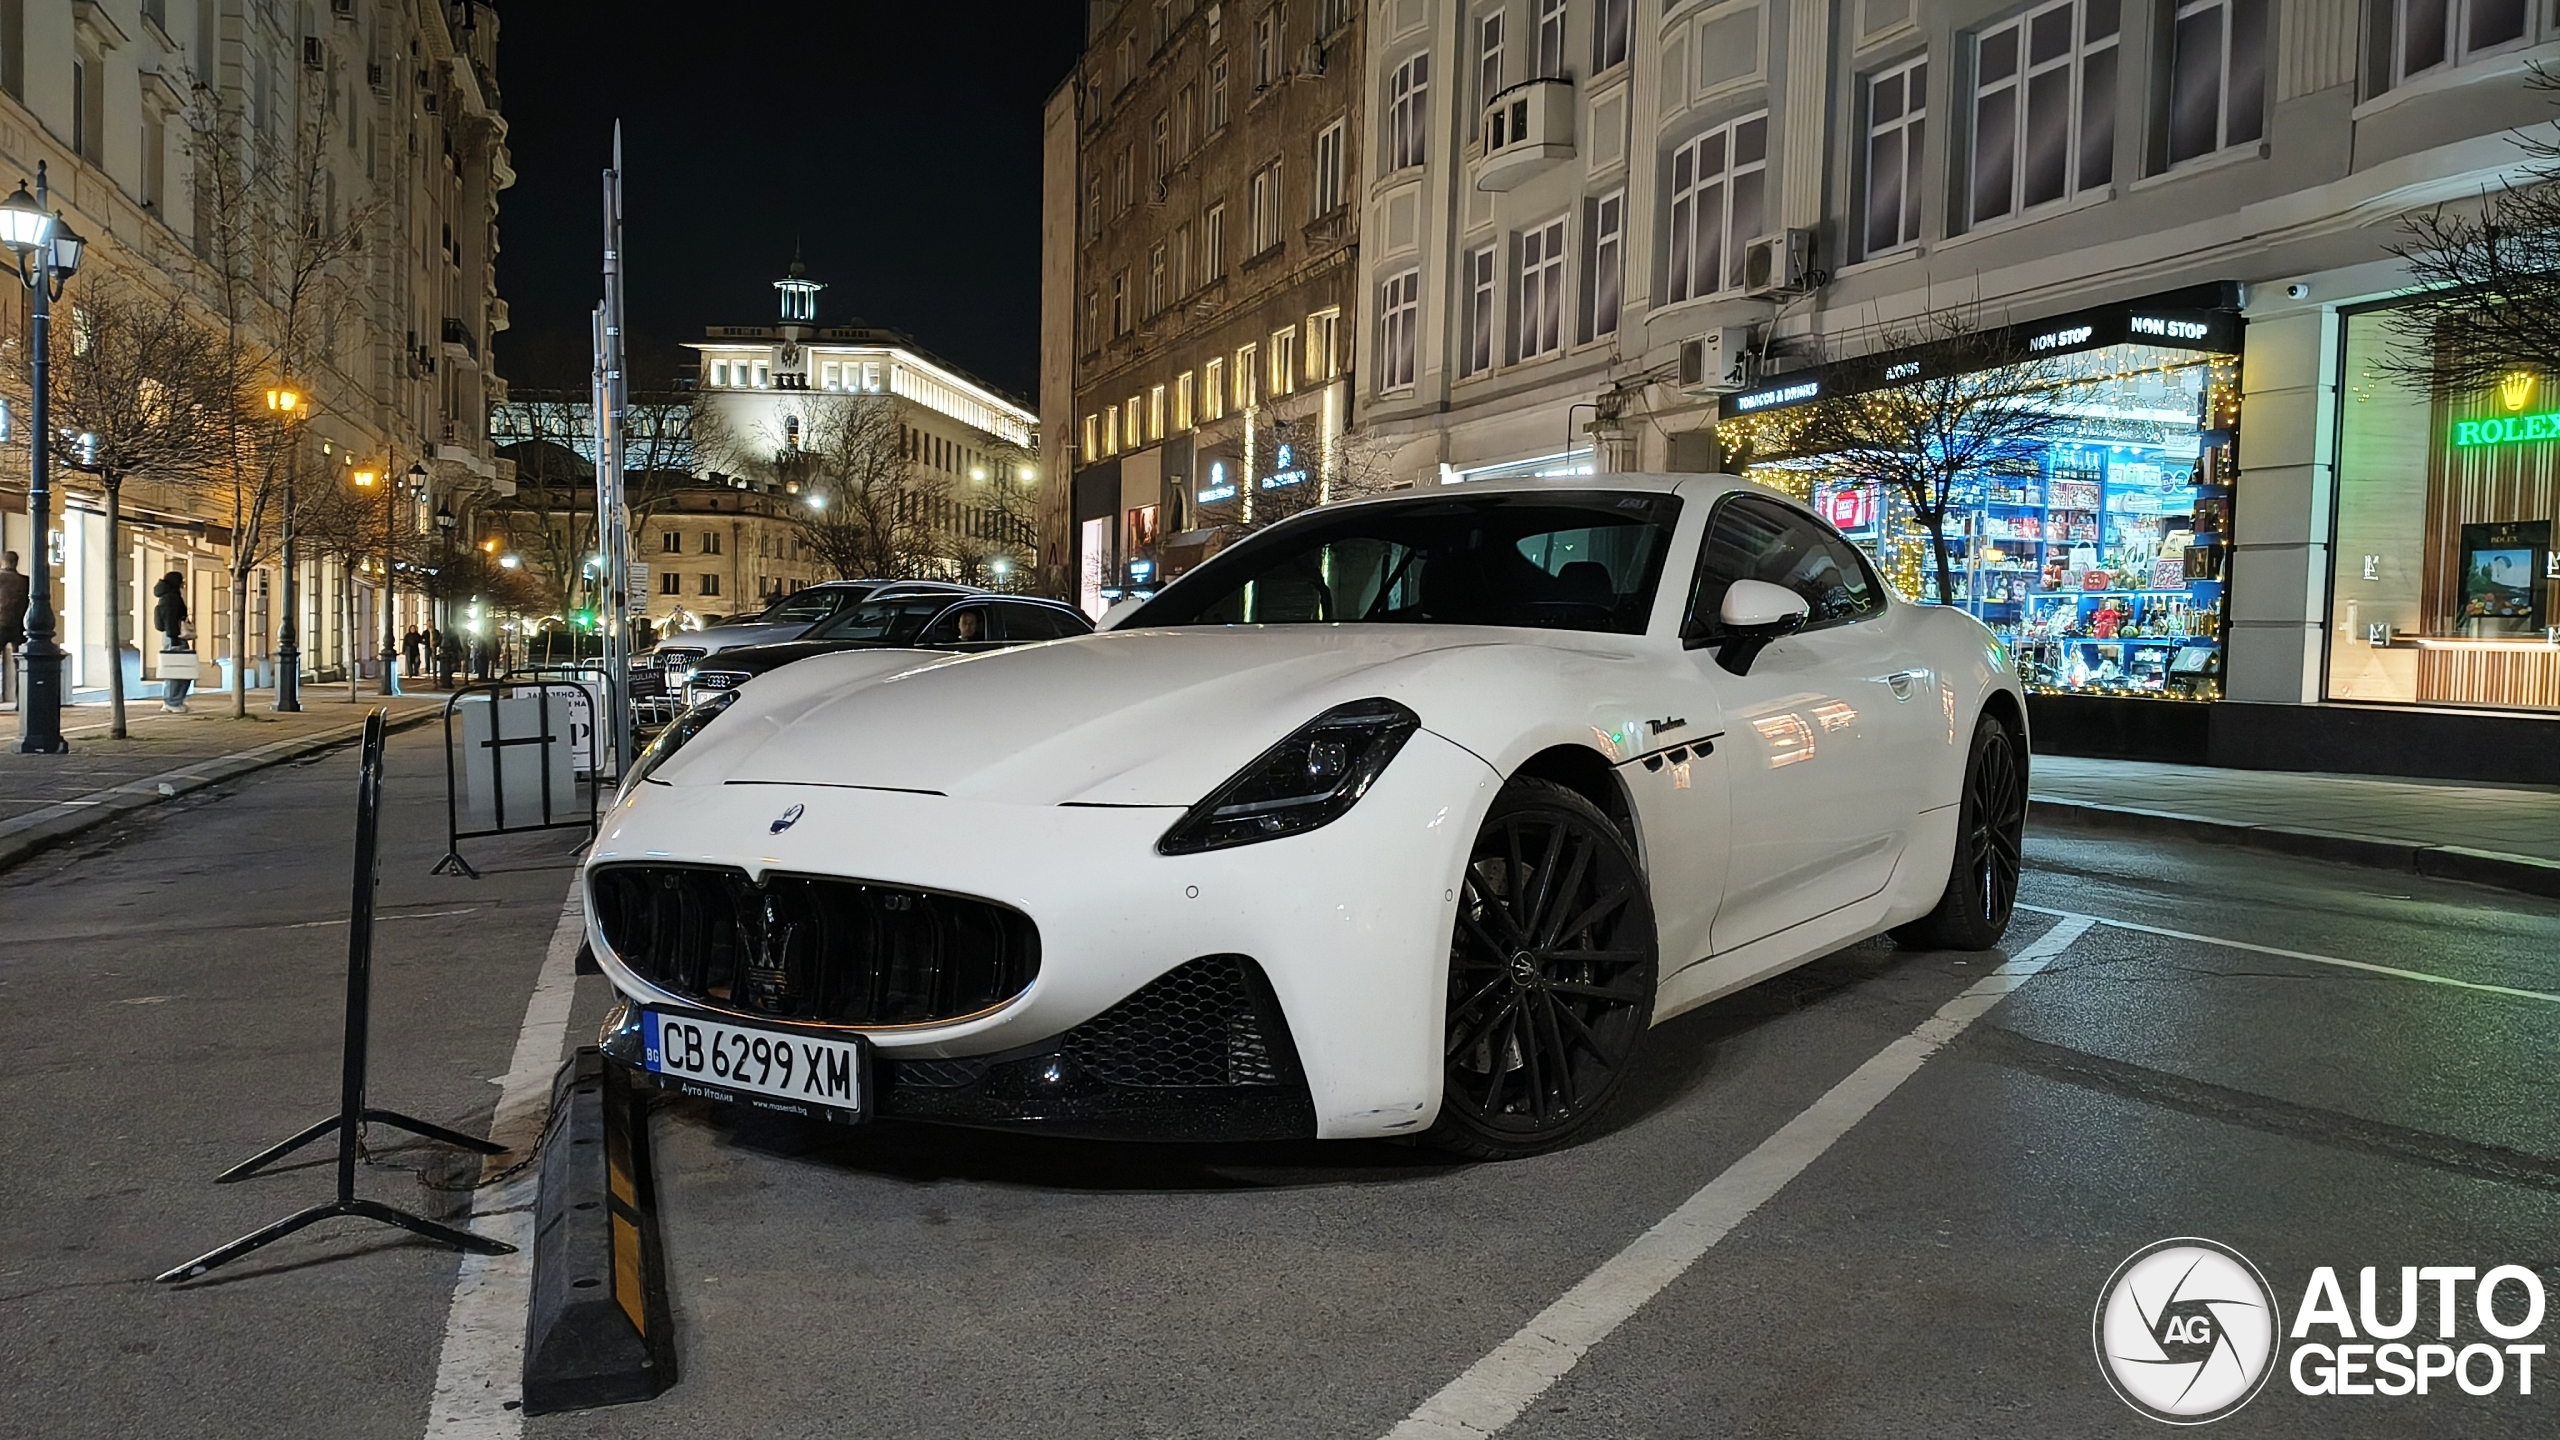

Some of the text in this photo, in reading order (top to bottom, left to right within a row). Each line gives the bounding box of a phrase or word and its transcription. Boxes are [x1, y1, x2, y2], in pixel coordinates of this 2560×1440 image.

[2030, 326, 2092, 351] NON STOP
[2131, 317, 2208, 340] NON STOP
[1739, 382, 1818, 410] TOBACCO & DRINKS
[2491, 536, 2518, 544] ROLEX
[527, 691, 575, 699] ЗАЗЕНО
[646, 1048, 659, 1063] BG
[664, 1022, 850, 1100] CB 6299 XM
[681, 1083, 734, 1102] Ауто Италия
